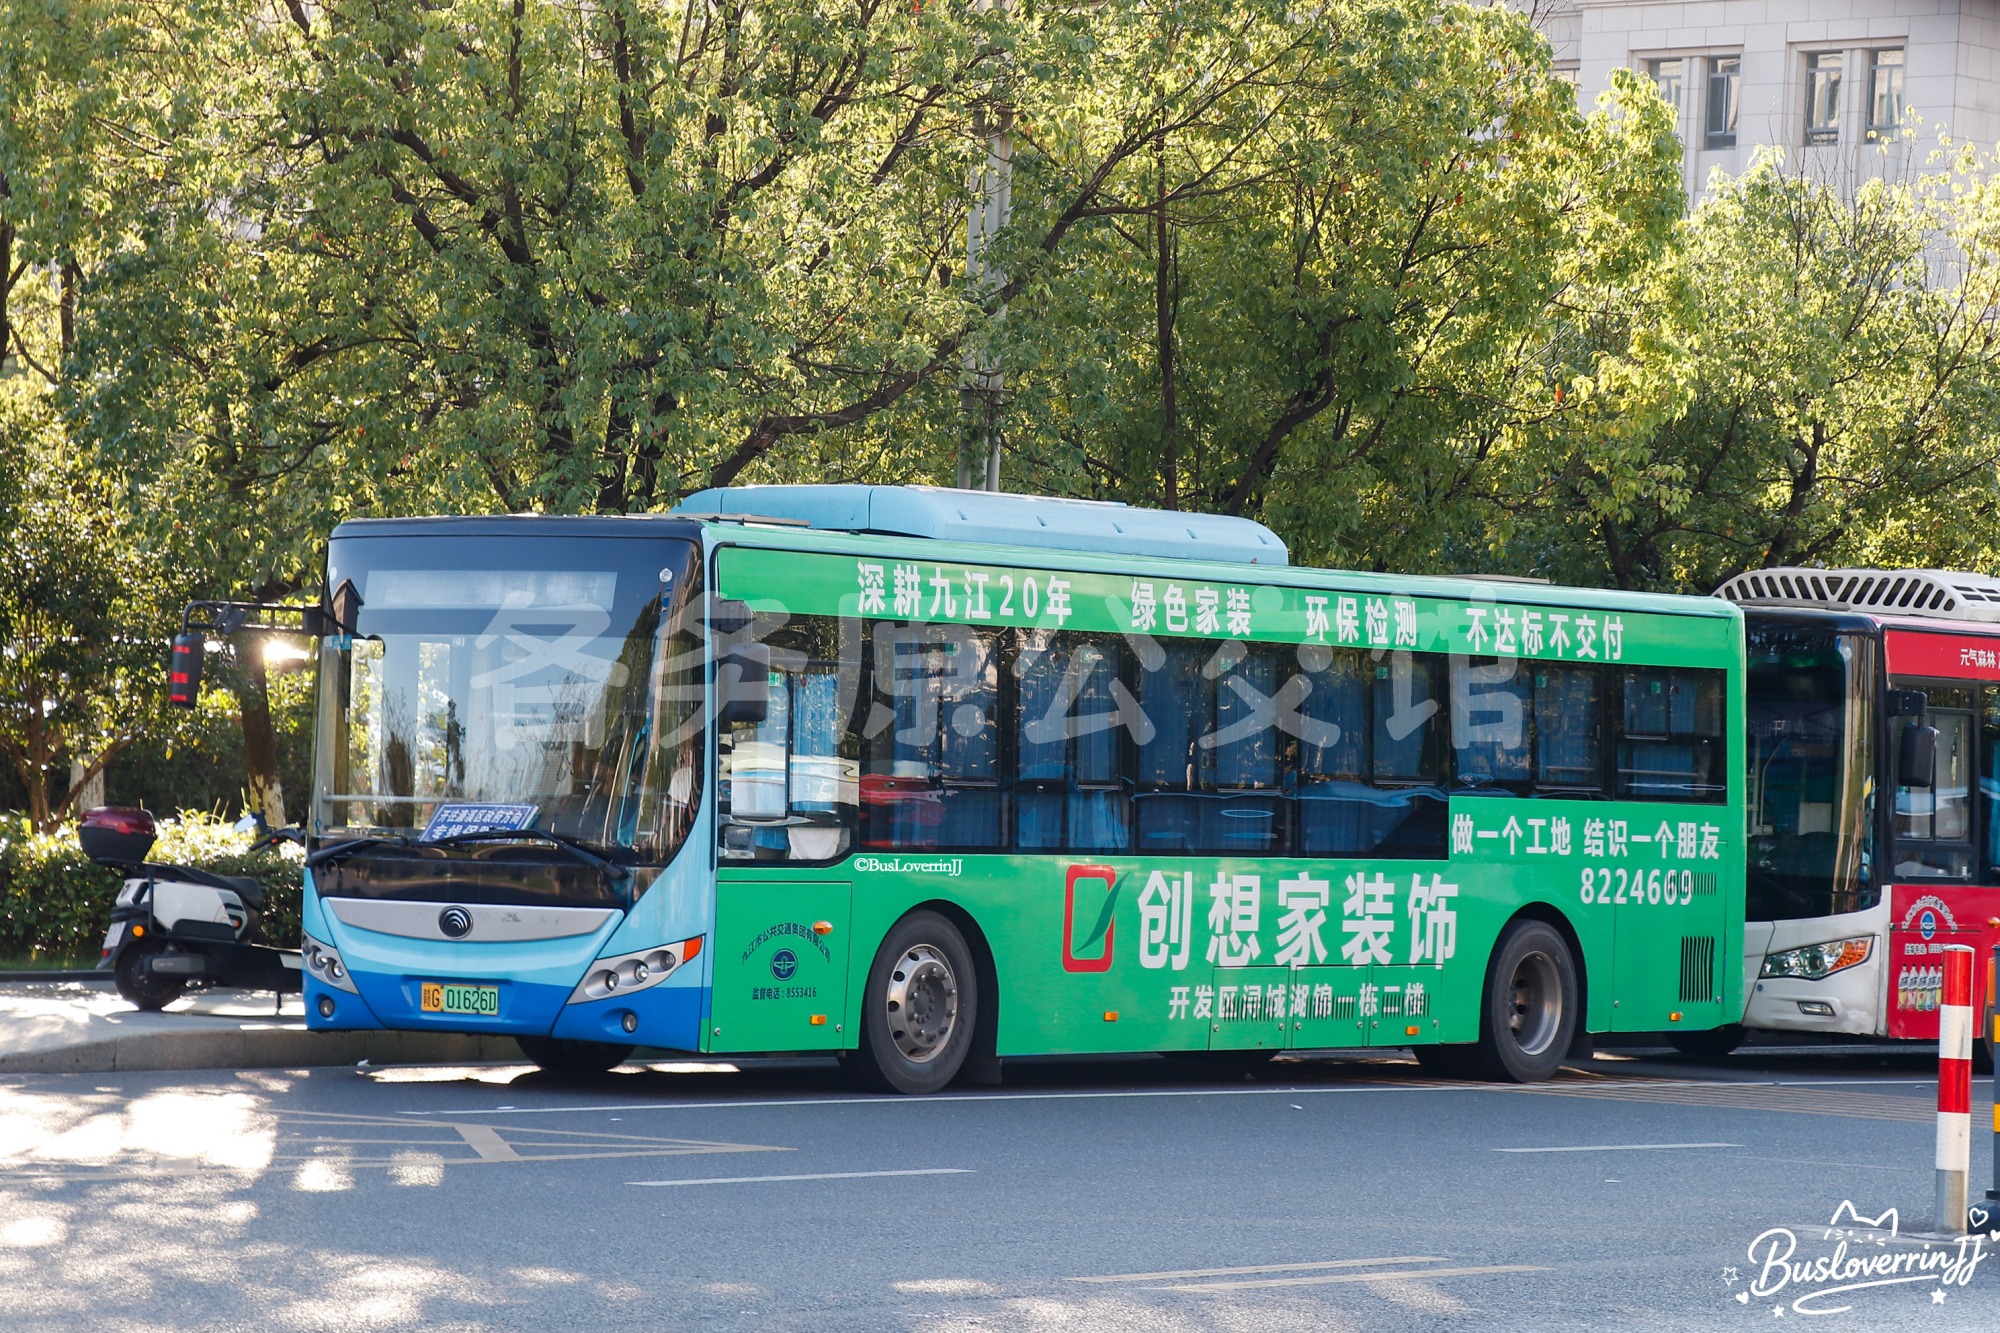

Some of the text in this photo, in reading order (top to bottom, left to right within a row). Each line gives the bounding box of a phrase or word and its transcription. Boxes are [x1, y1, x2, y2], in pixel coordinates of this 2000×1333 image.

[857, 561, 1624, 661] 深耕九江20年 绿色家装 环保检测 不达标不交付
[1451, 813, 1720, 860] 做一个工地 结识一个朋友
[1579, 867, 1693, 906] 8224669
[1137, 870, 1460, 971] 创想家装饰
[1168, 981, 1425, 1020] 开发区浔城湖锦一栋二楼
